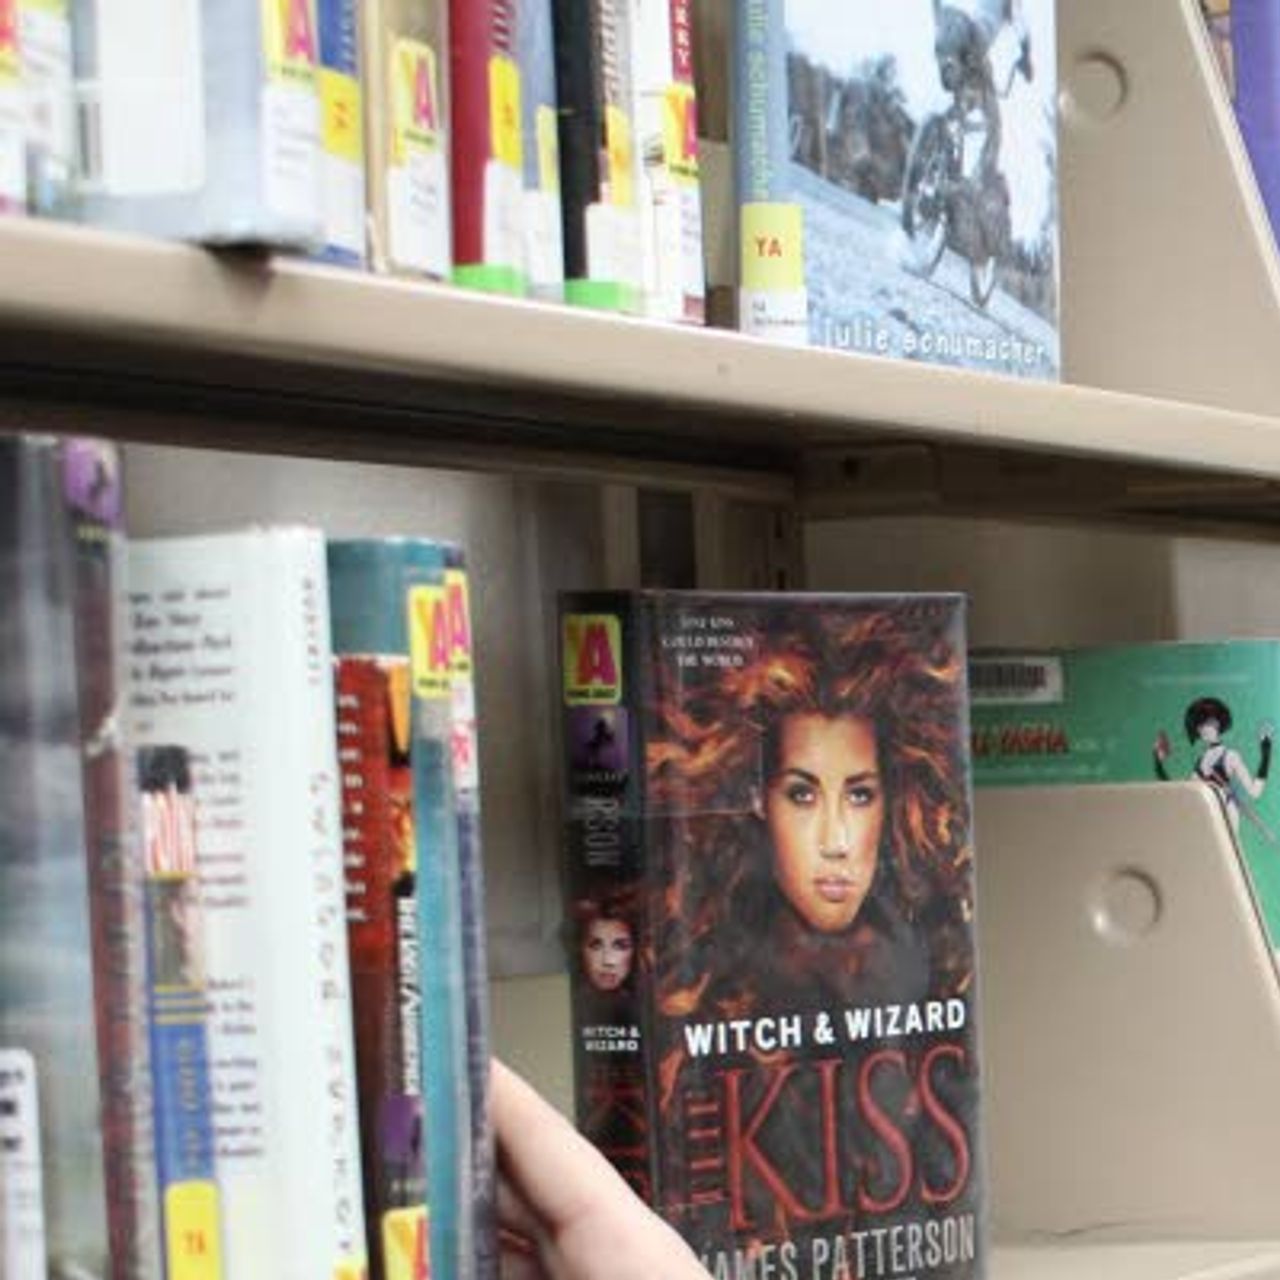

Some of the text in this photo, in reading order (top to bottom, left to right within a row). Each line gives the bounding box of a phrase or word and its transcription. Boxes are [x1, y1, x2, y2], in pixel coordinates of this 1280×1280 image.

[755, 237, 782, 257] YA
[823, 315, 889, 351] julie
[903, 327, 1044, 363] schumacher
[684, 998, 967, 1058] WITCH & WIZARD
[717, 1043, 972, 1231] KISS
